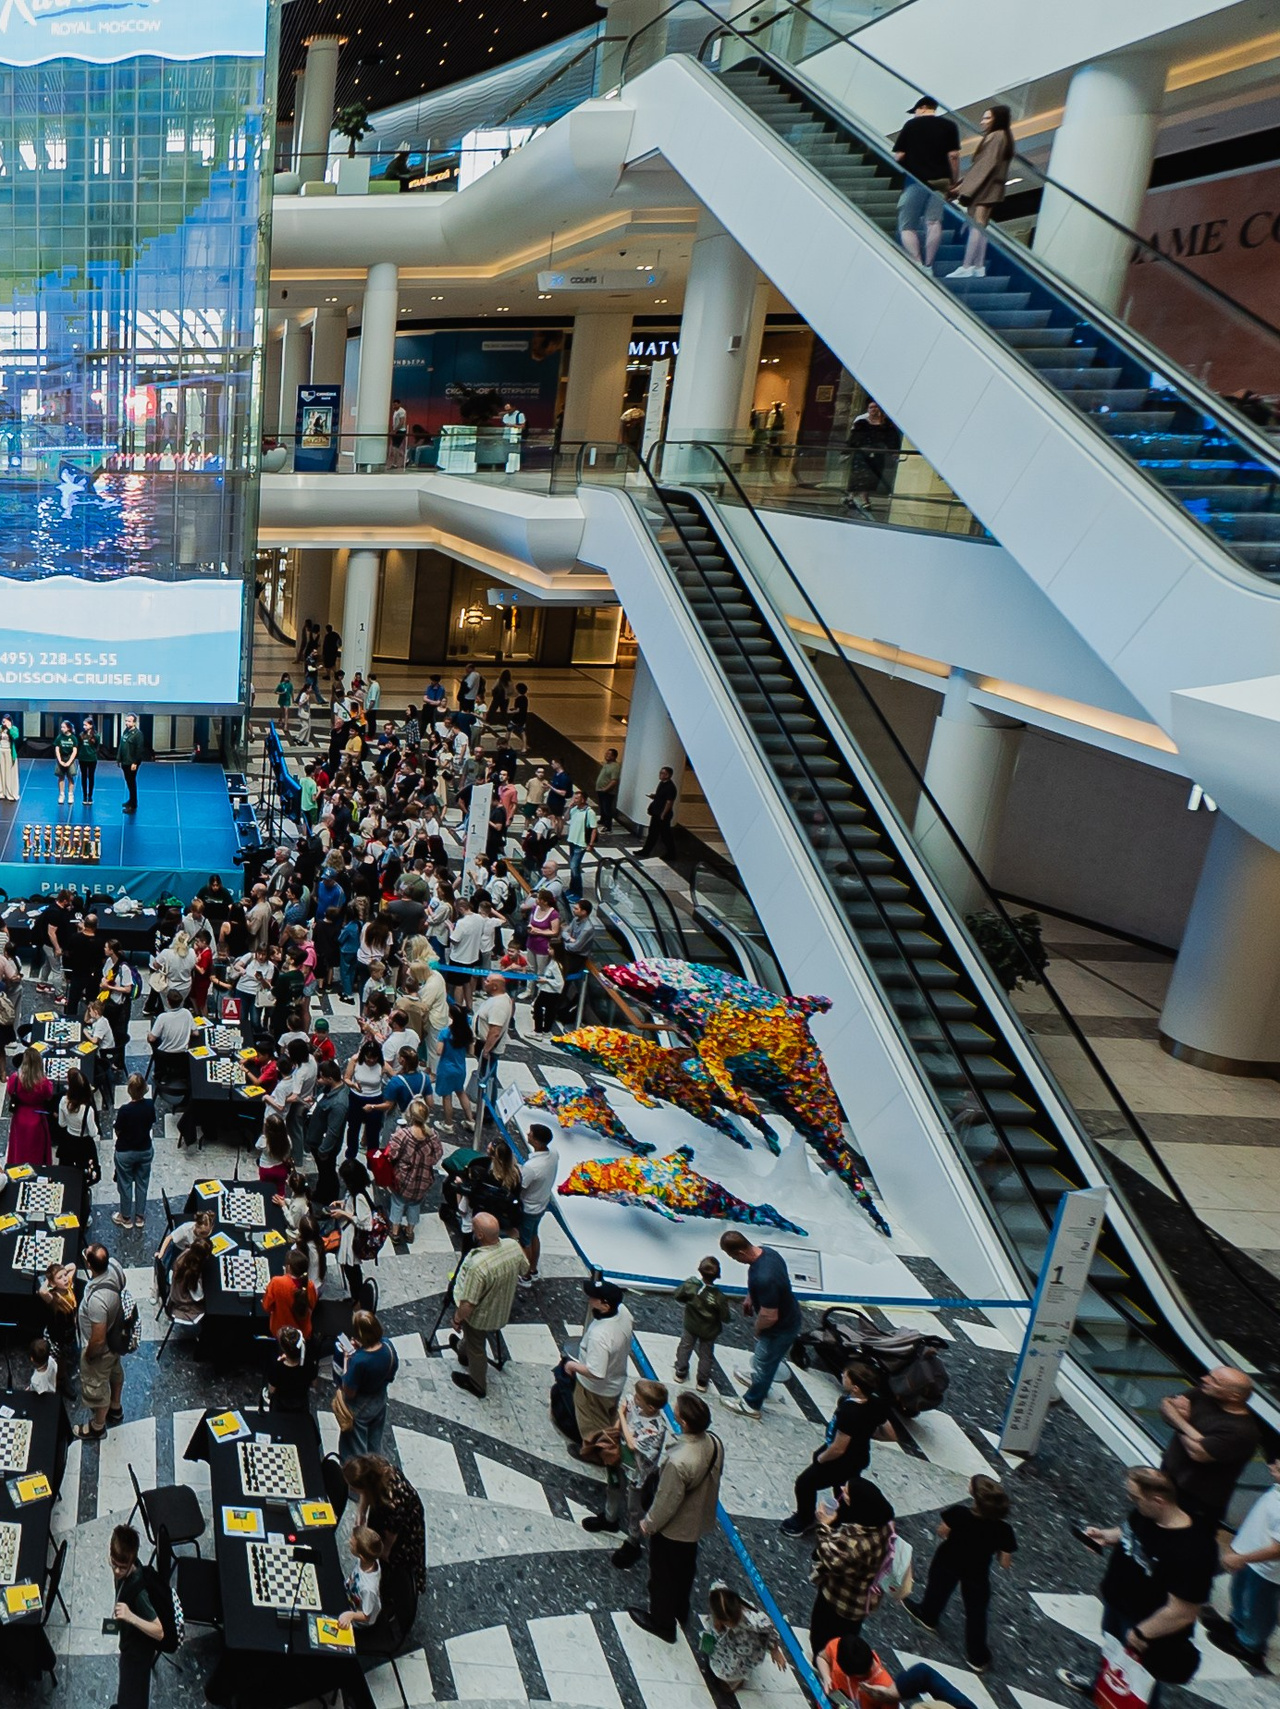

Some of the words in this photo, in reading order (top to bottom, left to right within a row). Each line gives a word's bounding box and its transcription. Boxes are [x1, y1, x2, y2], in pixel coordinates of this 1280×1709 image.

[51, 21, 96, 35] ROYAL
[99, 19, 162, 33] MOSCOW
[1130, 219, 1228, 264] AME
[651, 382, 659, 392] 2
[359, 622, 365, 632] 1
[39, 652, 117, 666] 228-55-55
[471, 824, 477, 835] 1
[41, 881, 128, 895] РИВЬЕРА
[225, 999, 239, 1015] A
[1087, 1216, 1097, 1227] 3
[1080, 1242, 1090, 1251] 2
[1050, 1266, 1064, 1285] 1
[1010, 1379, 1032, 1431] РИВЬЕРА
